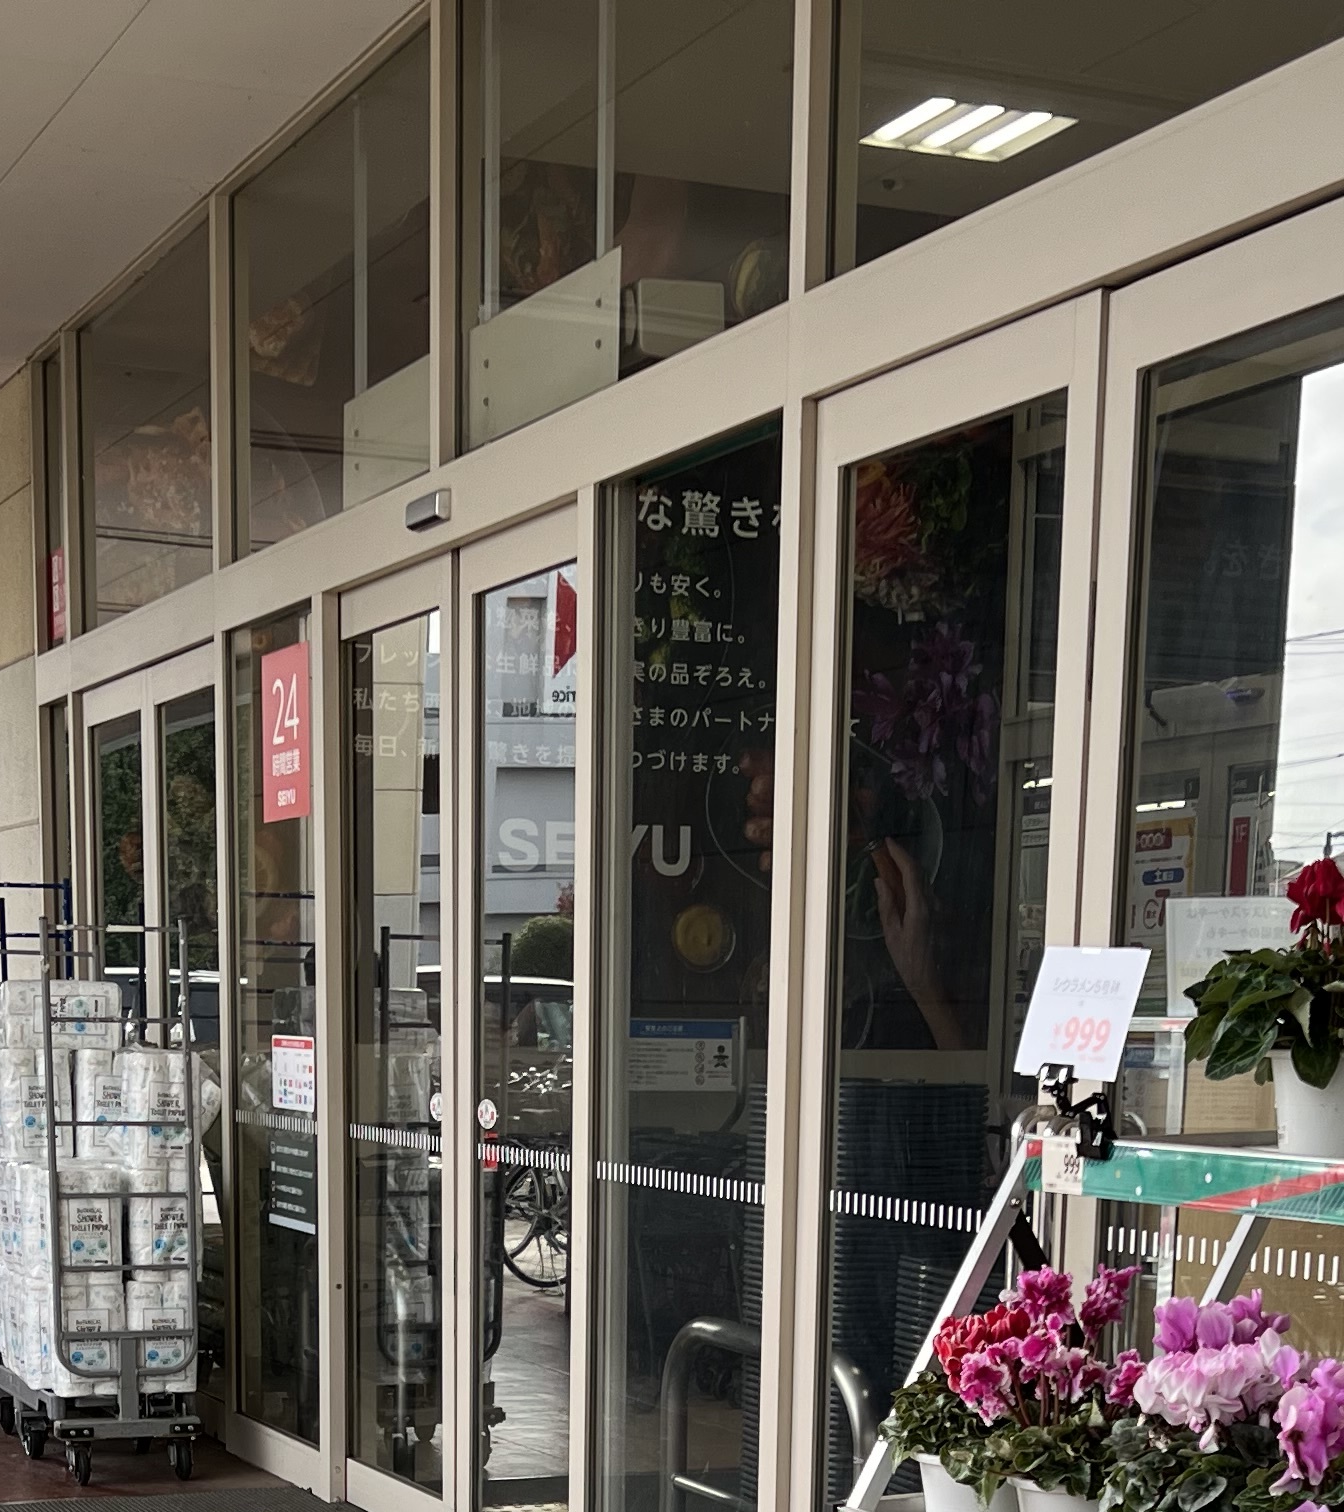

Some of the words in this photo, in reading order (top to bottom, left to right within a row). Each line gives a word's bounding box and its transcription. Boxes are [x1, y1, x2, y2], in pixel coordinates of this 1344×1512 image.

[637, 488, 782, 539] な驚き
[272, 673, 300, 745] 24
[277, 788, 296, 807] SEIYU
